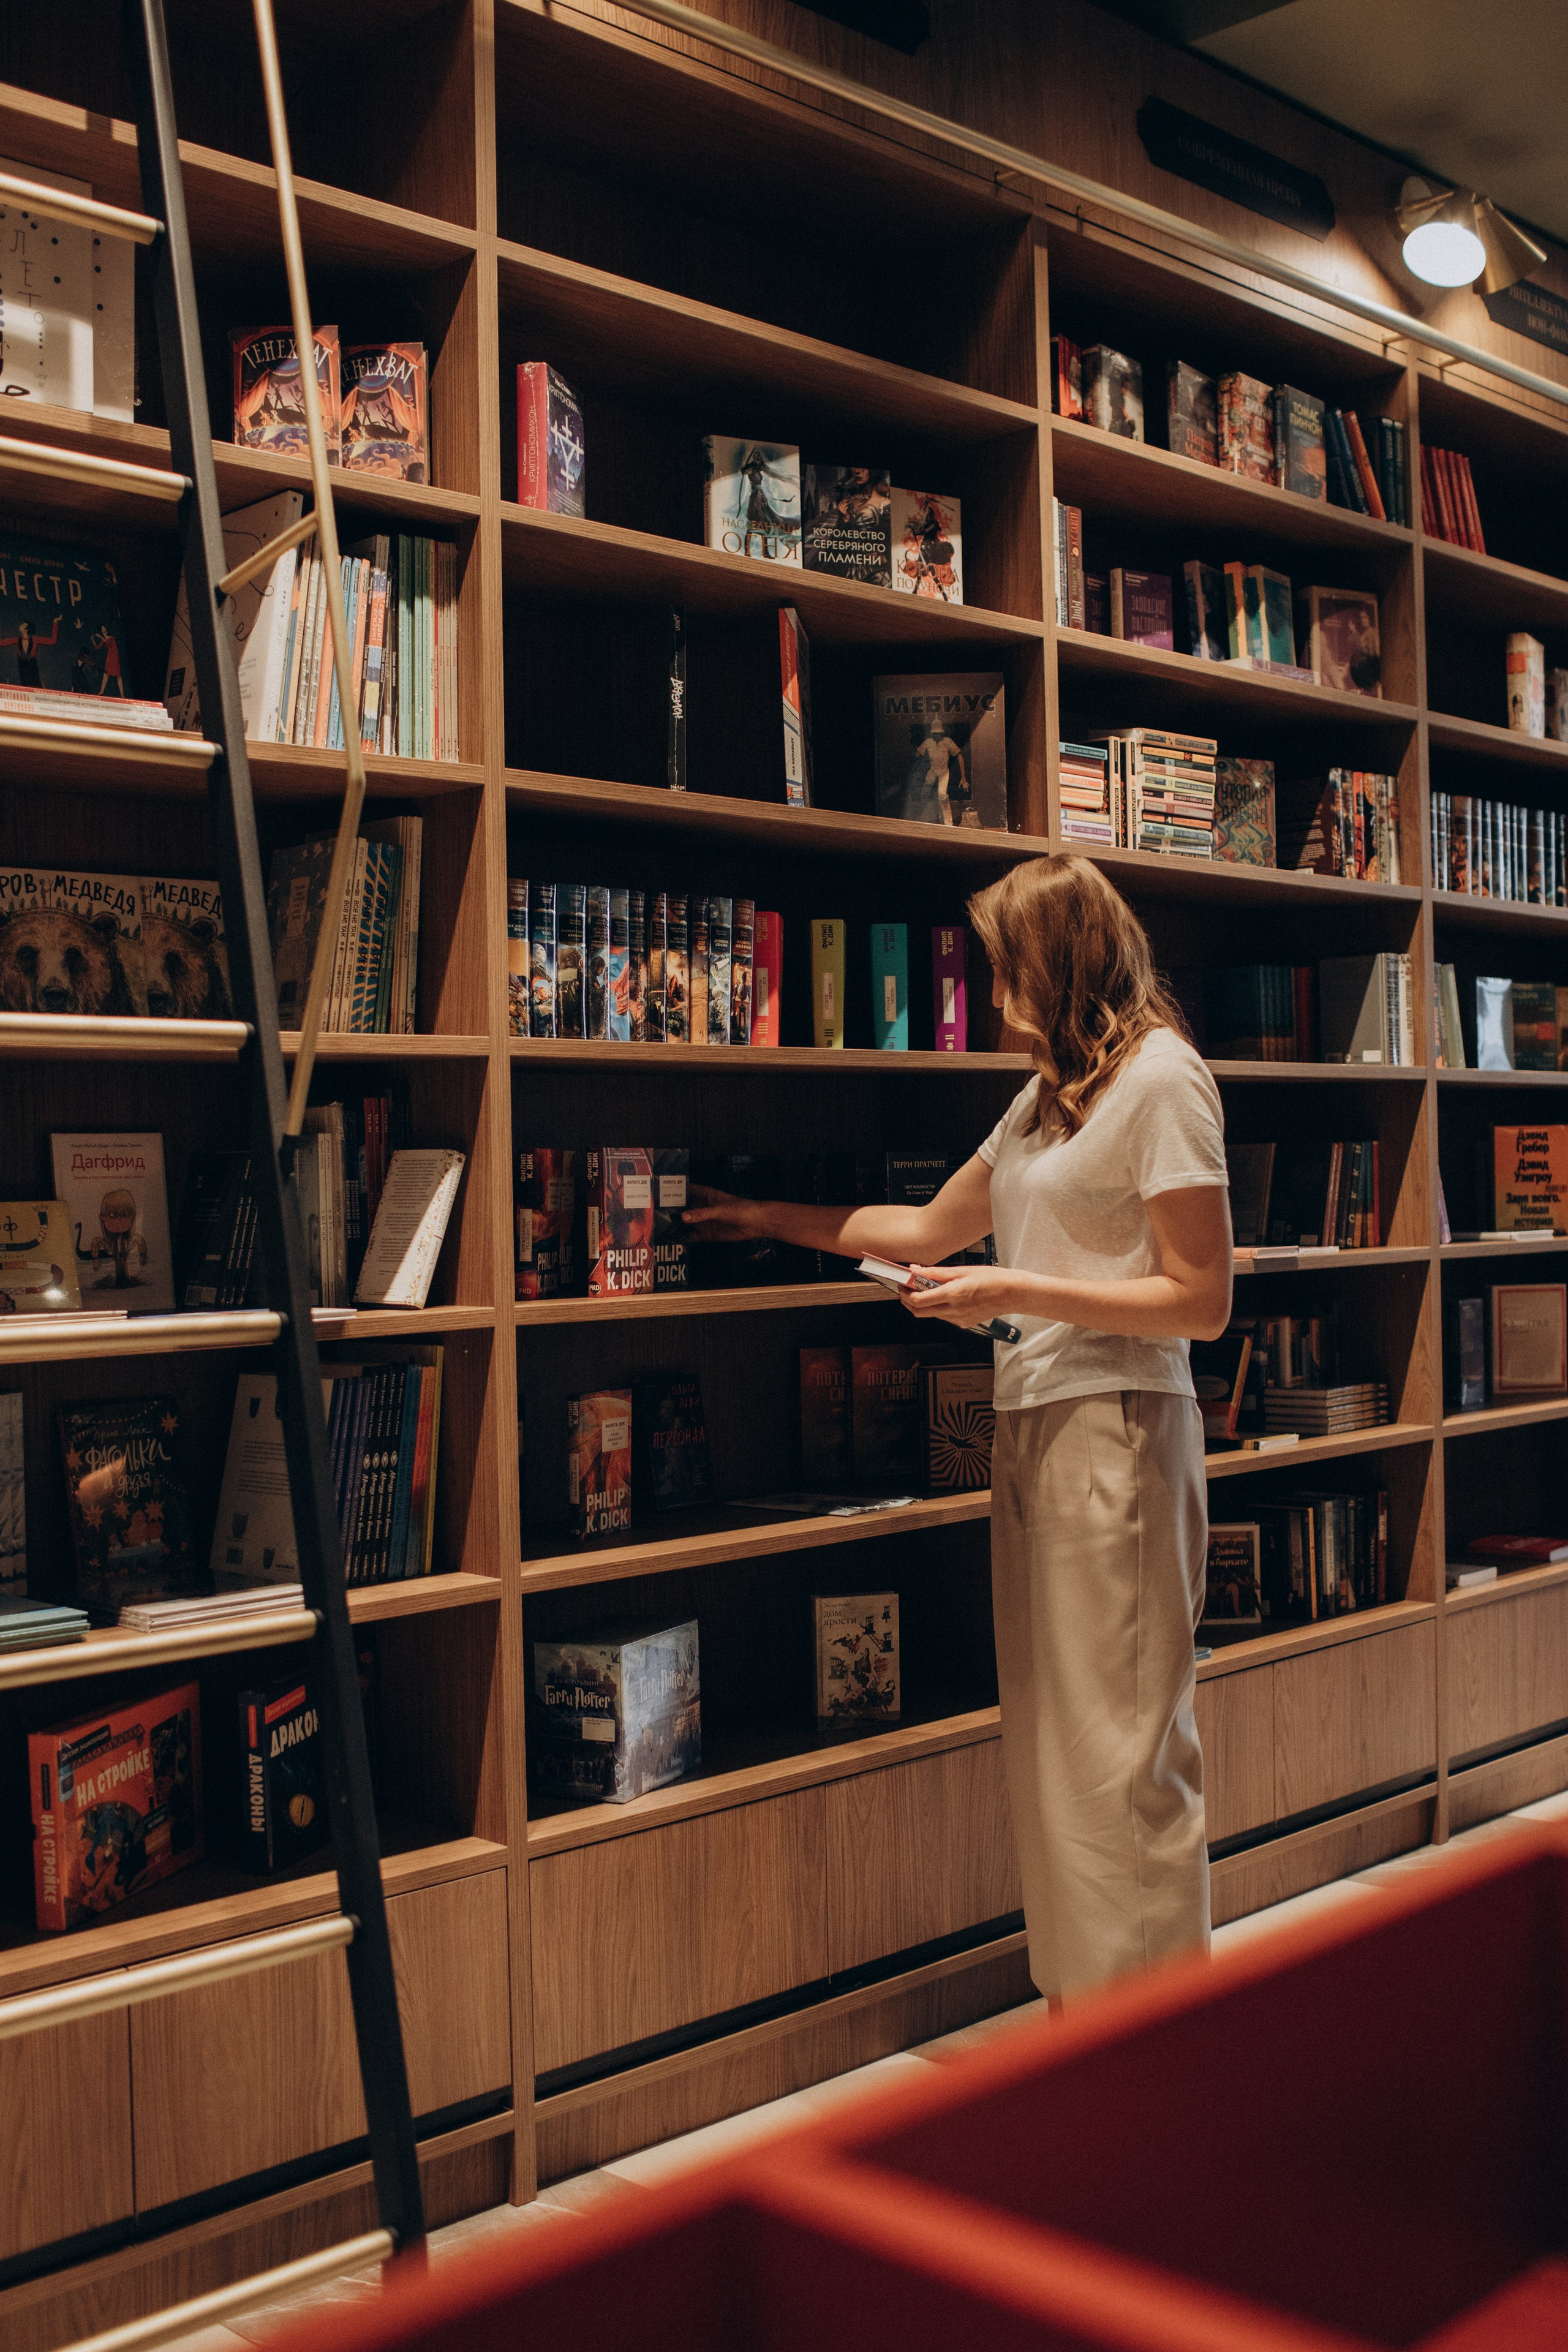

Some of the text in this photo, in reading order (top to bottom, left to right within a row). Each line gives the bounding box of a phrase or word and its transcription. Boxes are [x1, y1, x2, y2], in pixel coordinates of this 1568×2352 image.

[240, 338, 333, 369] ТЕНЕХАТ
[341, 351, 419, 387] ЕНЕХВАТ
[1292, 401, 1320, 421] ТОМАС
[528, 405, 537, 483] КРИПТОНОМИКОН
[813, 527, 886, 541] КОРОЛЕВСТВО
[722, 531, 798, 561] ОГНЯ
[813, 539, 886, 554] СЕРЕБРЯНОГО
[818, 551, 882, 567] ПЛАМЕНИ
[896, 559, 960, 583] КОРОНА
[53, 874, 135, 916] МЕДВЕДЯ
[1516, 1141, 1550, 1154] Гребер
[1517, 1130, 1548, 1142] Дэвид
[71, 1153, 146, 1172] Дагфрид
[1517, 1158, 1549, 1171] Дэвид
[1514, 1170, 1552, 1183] Уэнгроу
[1506, 1193, 1529, 1204] Заря
[537, 1251, 557, 1272] PHILIP
[607, 1248, 648, 1268] PHILIP
[607, 1269, 651, 1291] K. DICK
[657, 1264, 686, 1283] DICK
[672, 1382, 696, 1396] ОЛЬГА
[653, 1424, 706, 1450] ПЕРСОНАЛ
[85, 1438, 172, 1472] ФАСОЛЬКИ
[104, 1472, 152, 1499] и друзья
[360, 1474, 369, 1496] Между
[369, 1472, 378, 1495] Между
[379, 1471, 387, 1494] Между
[388, 1469, 396, 1493] Между
[586, 1487, 625, 1512] PHILIP
[586, 1507, 628, 1534] K. DICK
[75, 1747, 150, 1808] НА СТРОЙКЕ
[248, 1753, 265, 1833] ДРАКОНЫ
[40, 1814, 57, 1904] НА СТРОЙКЕ
